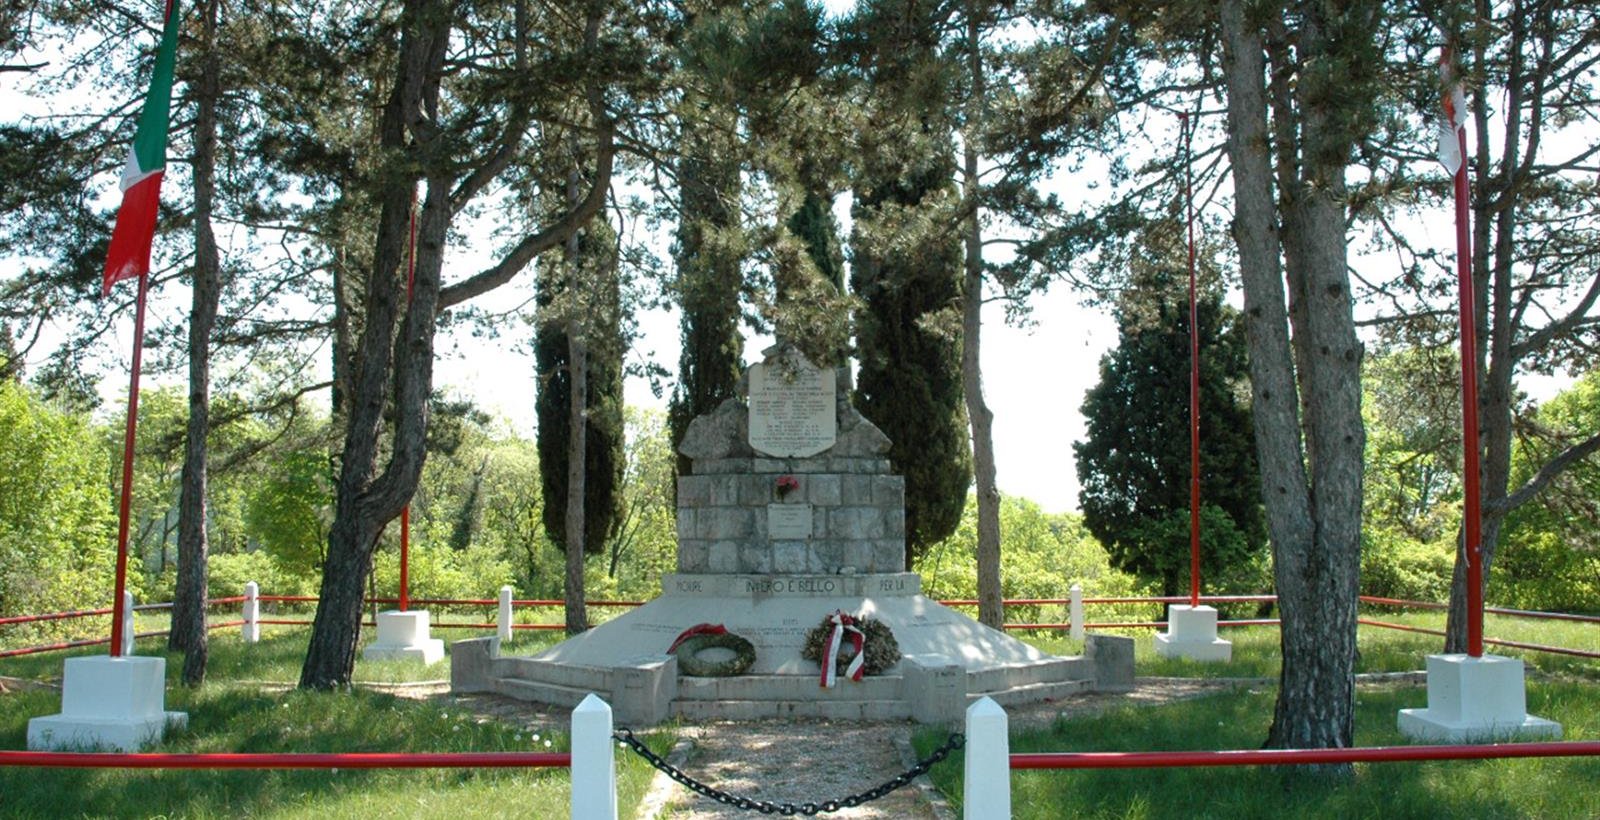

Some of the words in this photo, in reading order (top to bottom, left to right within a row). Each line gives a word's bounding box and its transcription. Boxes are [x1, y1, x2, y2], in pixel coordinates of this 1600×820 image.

[799, 580, 835, 593] BELLO
[880, 580, 893, 591] PER
[896, 580, 904, 591] LA
